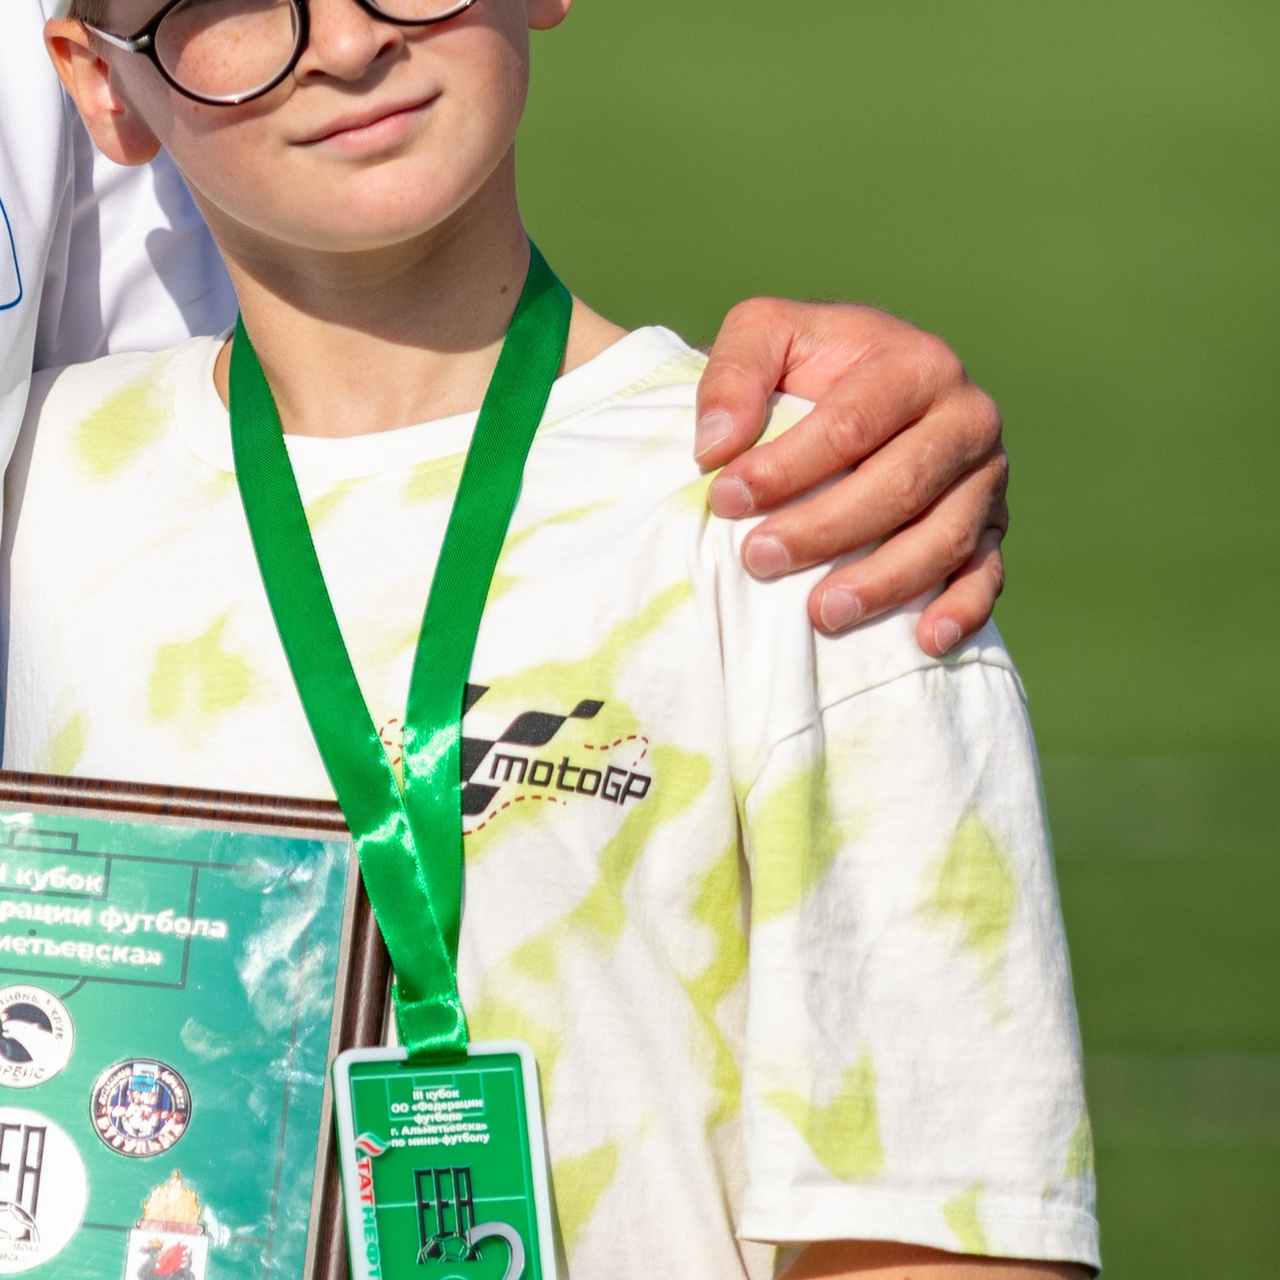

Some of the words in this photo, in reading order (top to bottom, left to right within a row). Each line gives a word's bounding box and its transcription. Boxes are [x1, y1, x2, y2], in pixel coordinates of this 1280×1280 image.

[16, 866, 102, 893] кубок
[99, 906, 228, 939] футбола
[425, 1088, 459, 1101] кубок
[411, 1099, 484, 1112] «Федерации
[413, 1112, 462, 1125] футбола
[390, 1128, 399, 1136] г.
[401, 1123, 488, 1136] Альметьевска»
[390, 1139, 406, 1147] по
[407, 1132, 490, 1146] мини-футболу
